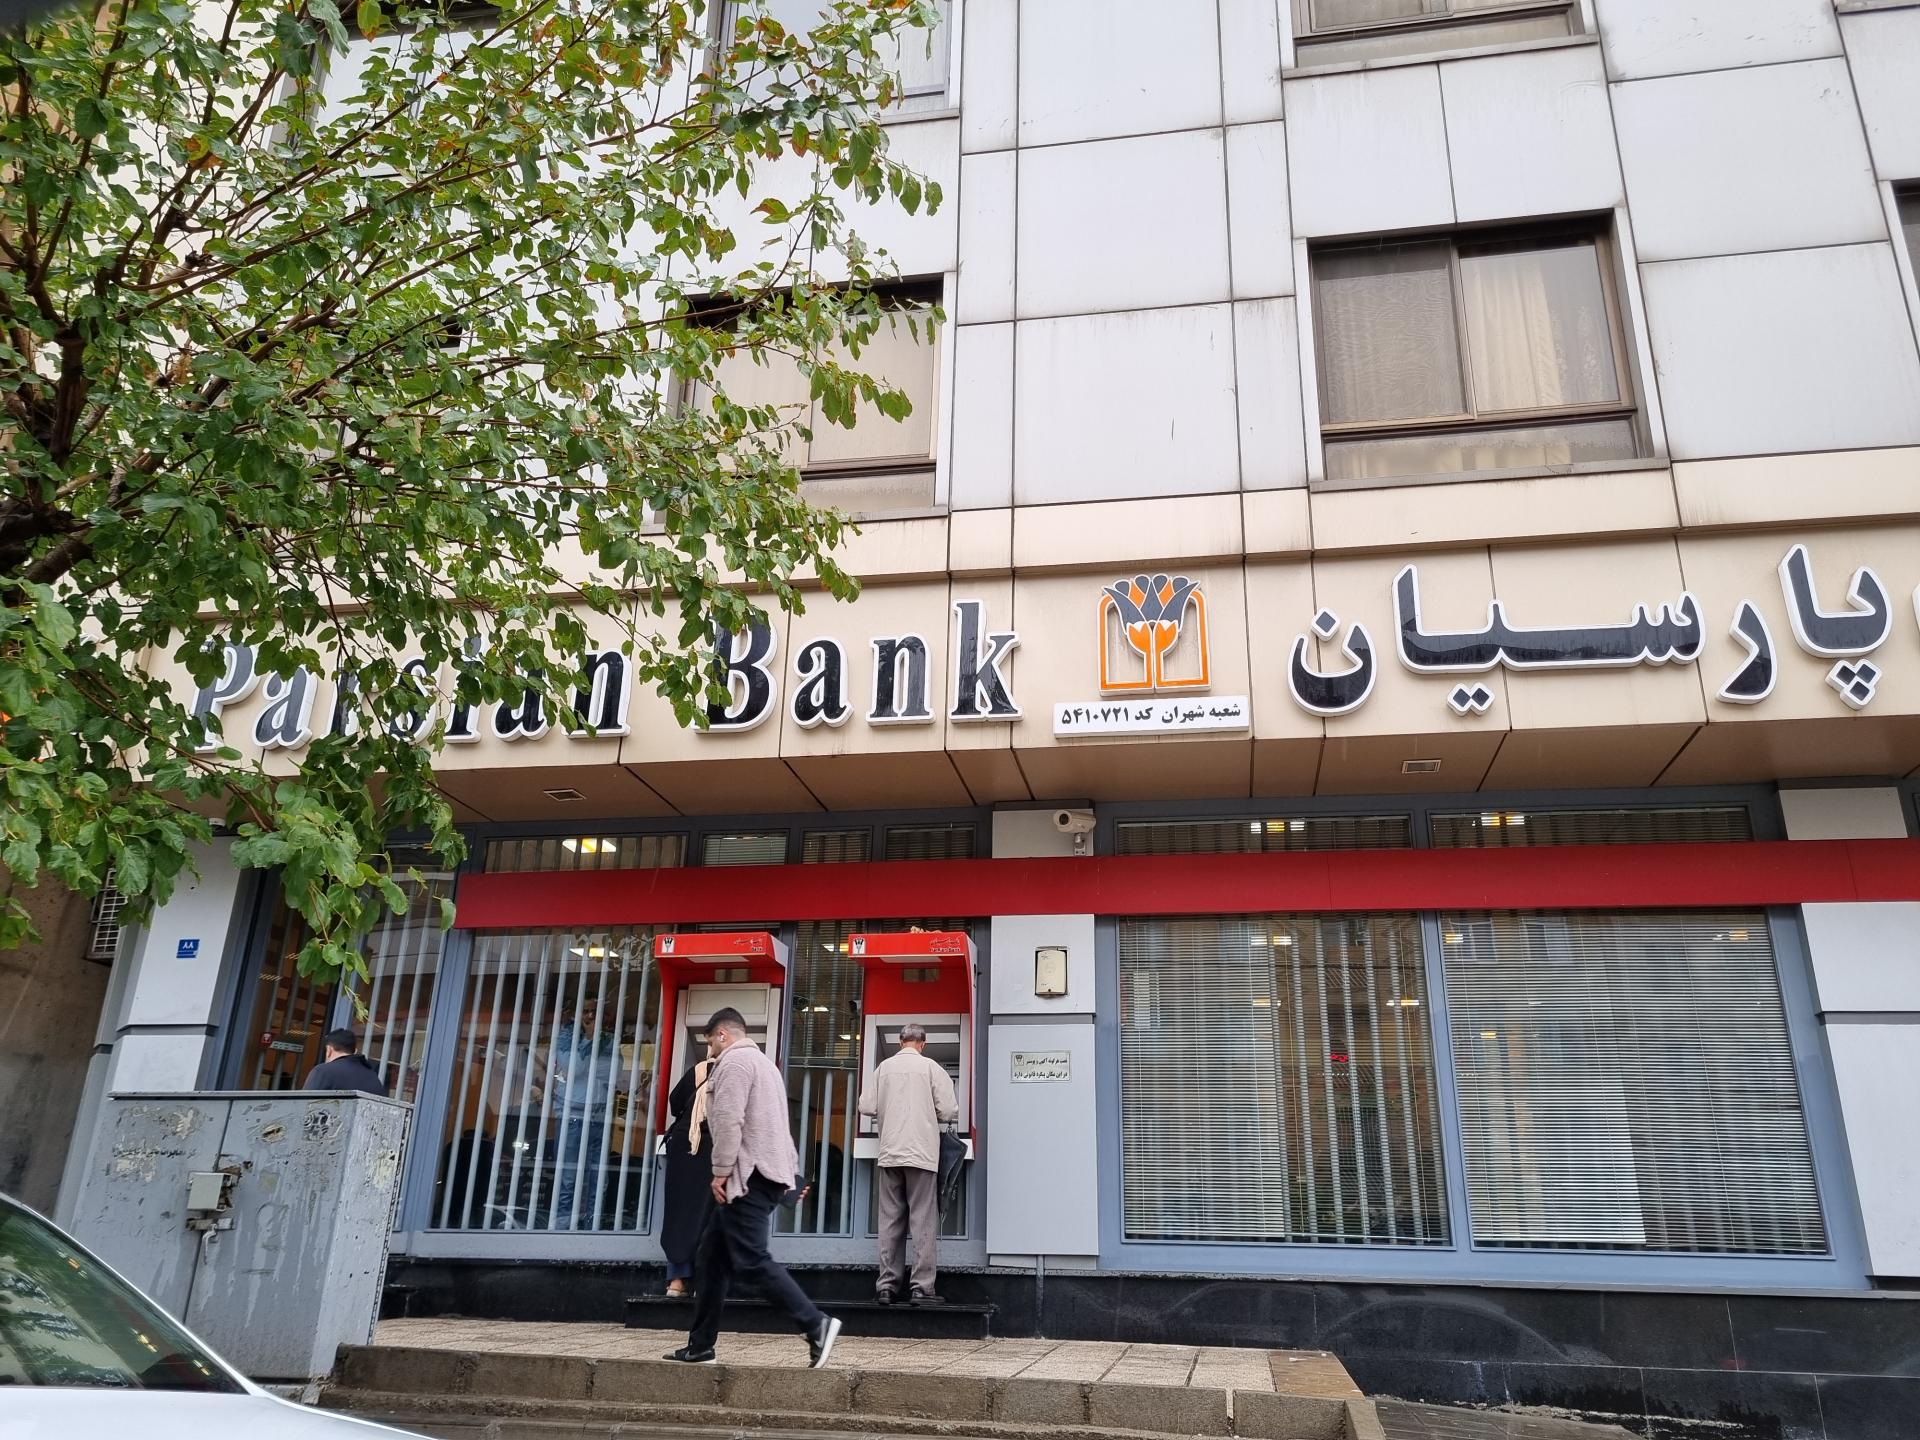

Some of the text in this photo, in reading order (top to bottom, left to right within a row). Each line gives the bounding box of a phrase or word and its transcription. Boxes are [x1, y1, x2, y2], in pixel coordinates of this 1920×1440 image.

[692, 598, 1023, 734] Bank
[1288, 543, 1894, 718] پارسیان
[1061, 703, 1241, 725] شعبه شهران کد ۵۴۱۰۷۲۱
